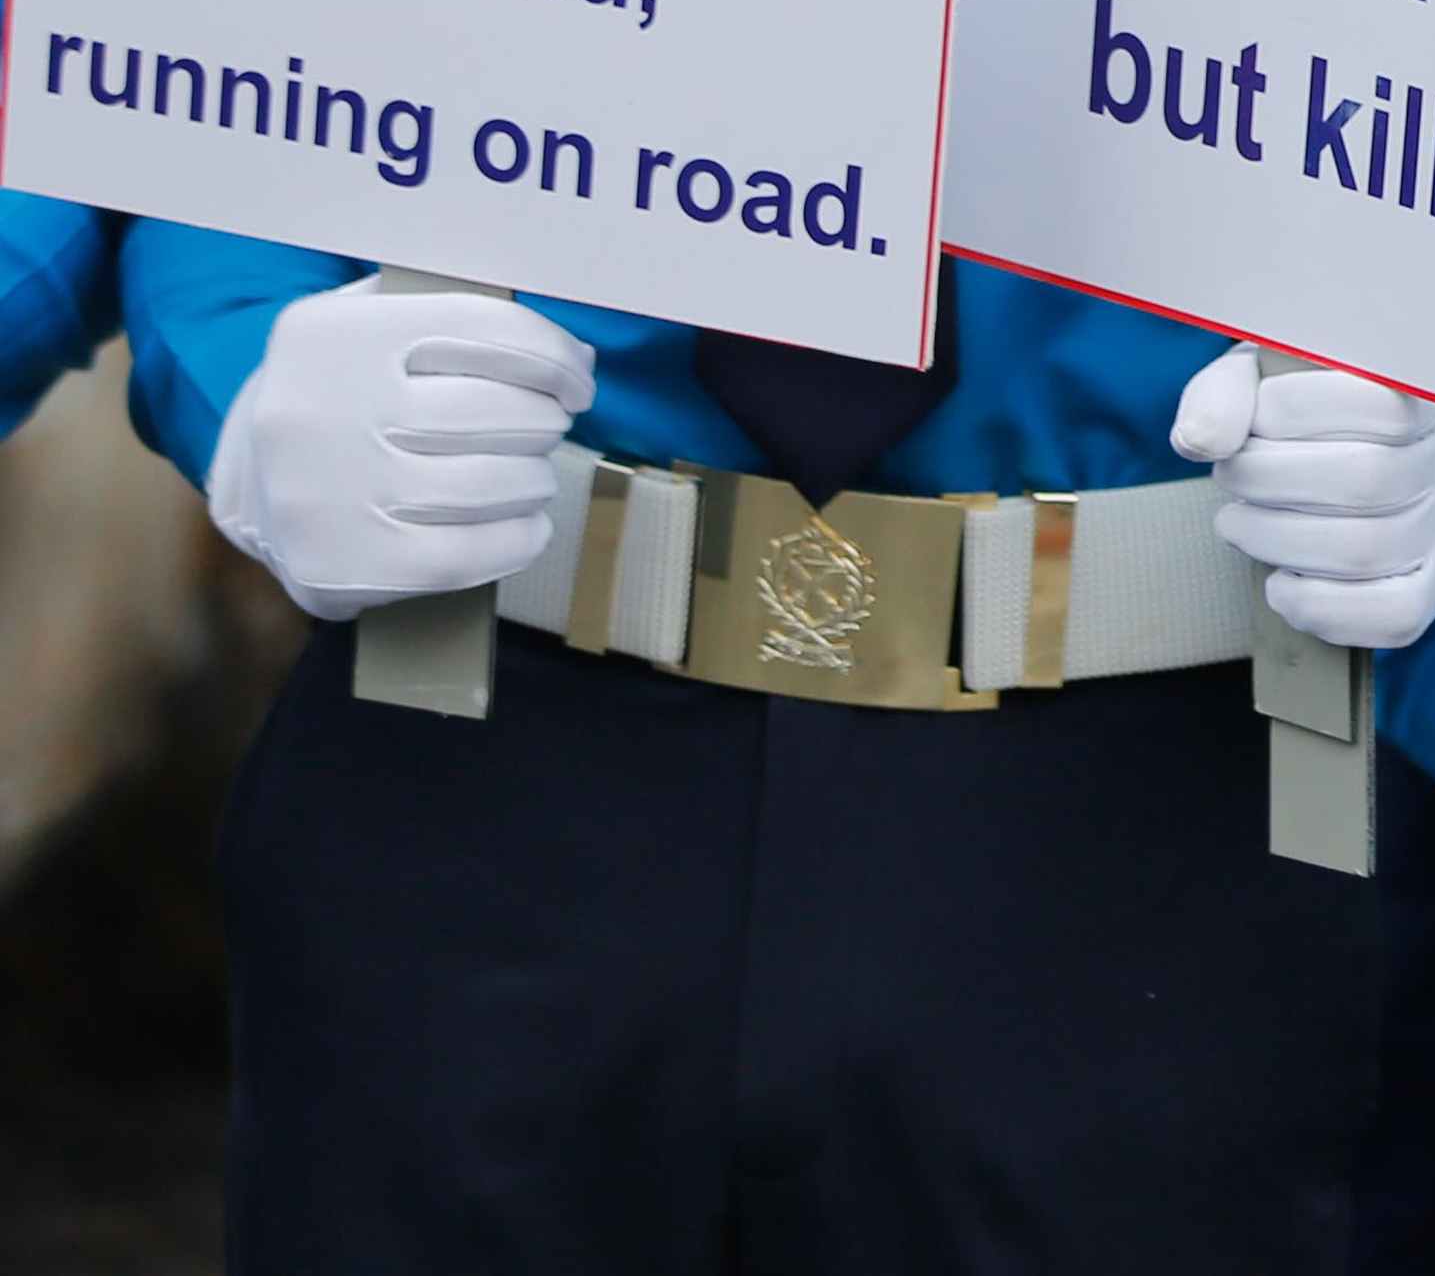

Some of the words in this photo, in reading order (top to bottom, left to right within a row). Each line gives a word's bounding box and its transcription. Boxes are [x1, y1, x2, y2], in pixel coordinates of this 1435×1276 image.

[47, 33, 433, 187] running
[473, 119, 593, 198] on
[635, 148, 886, 256] road.
